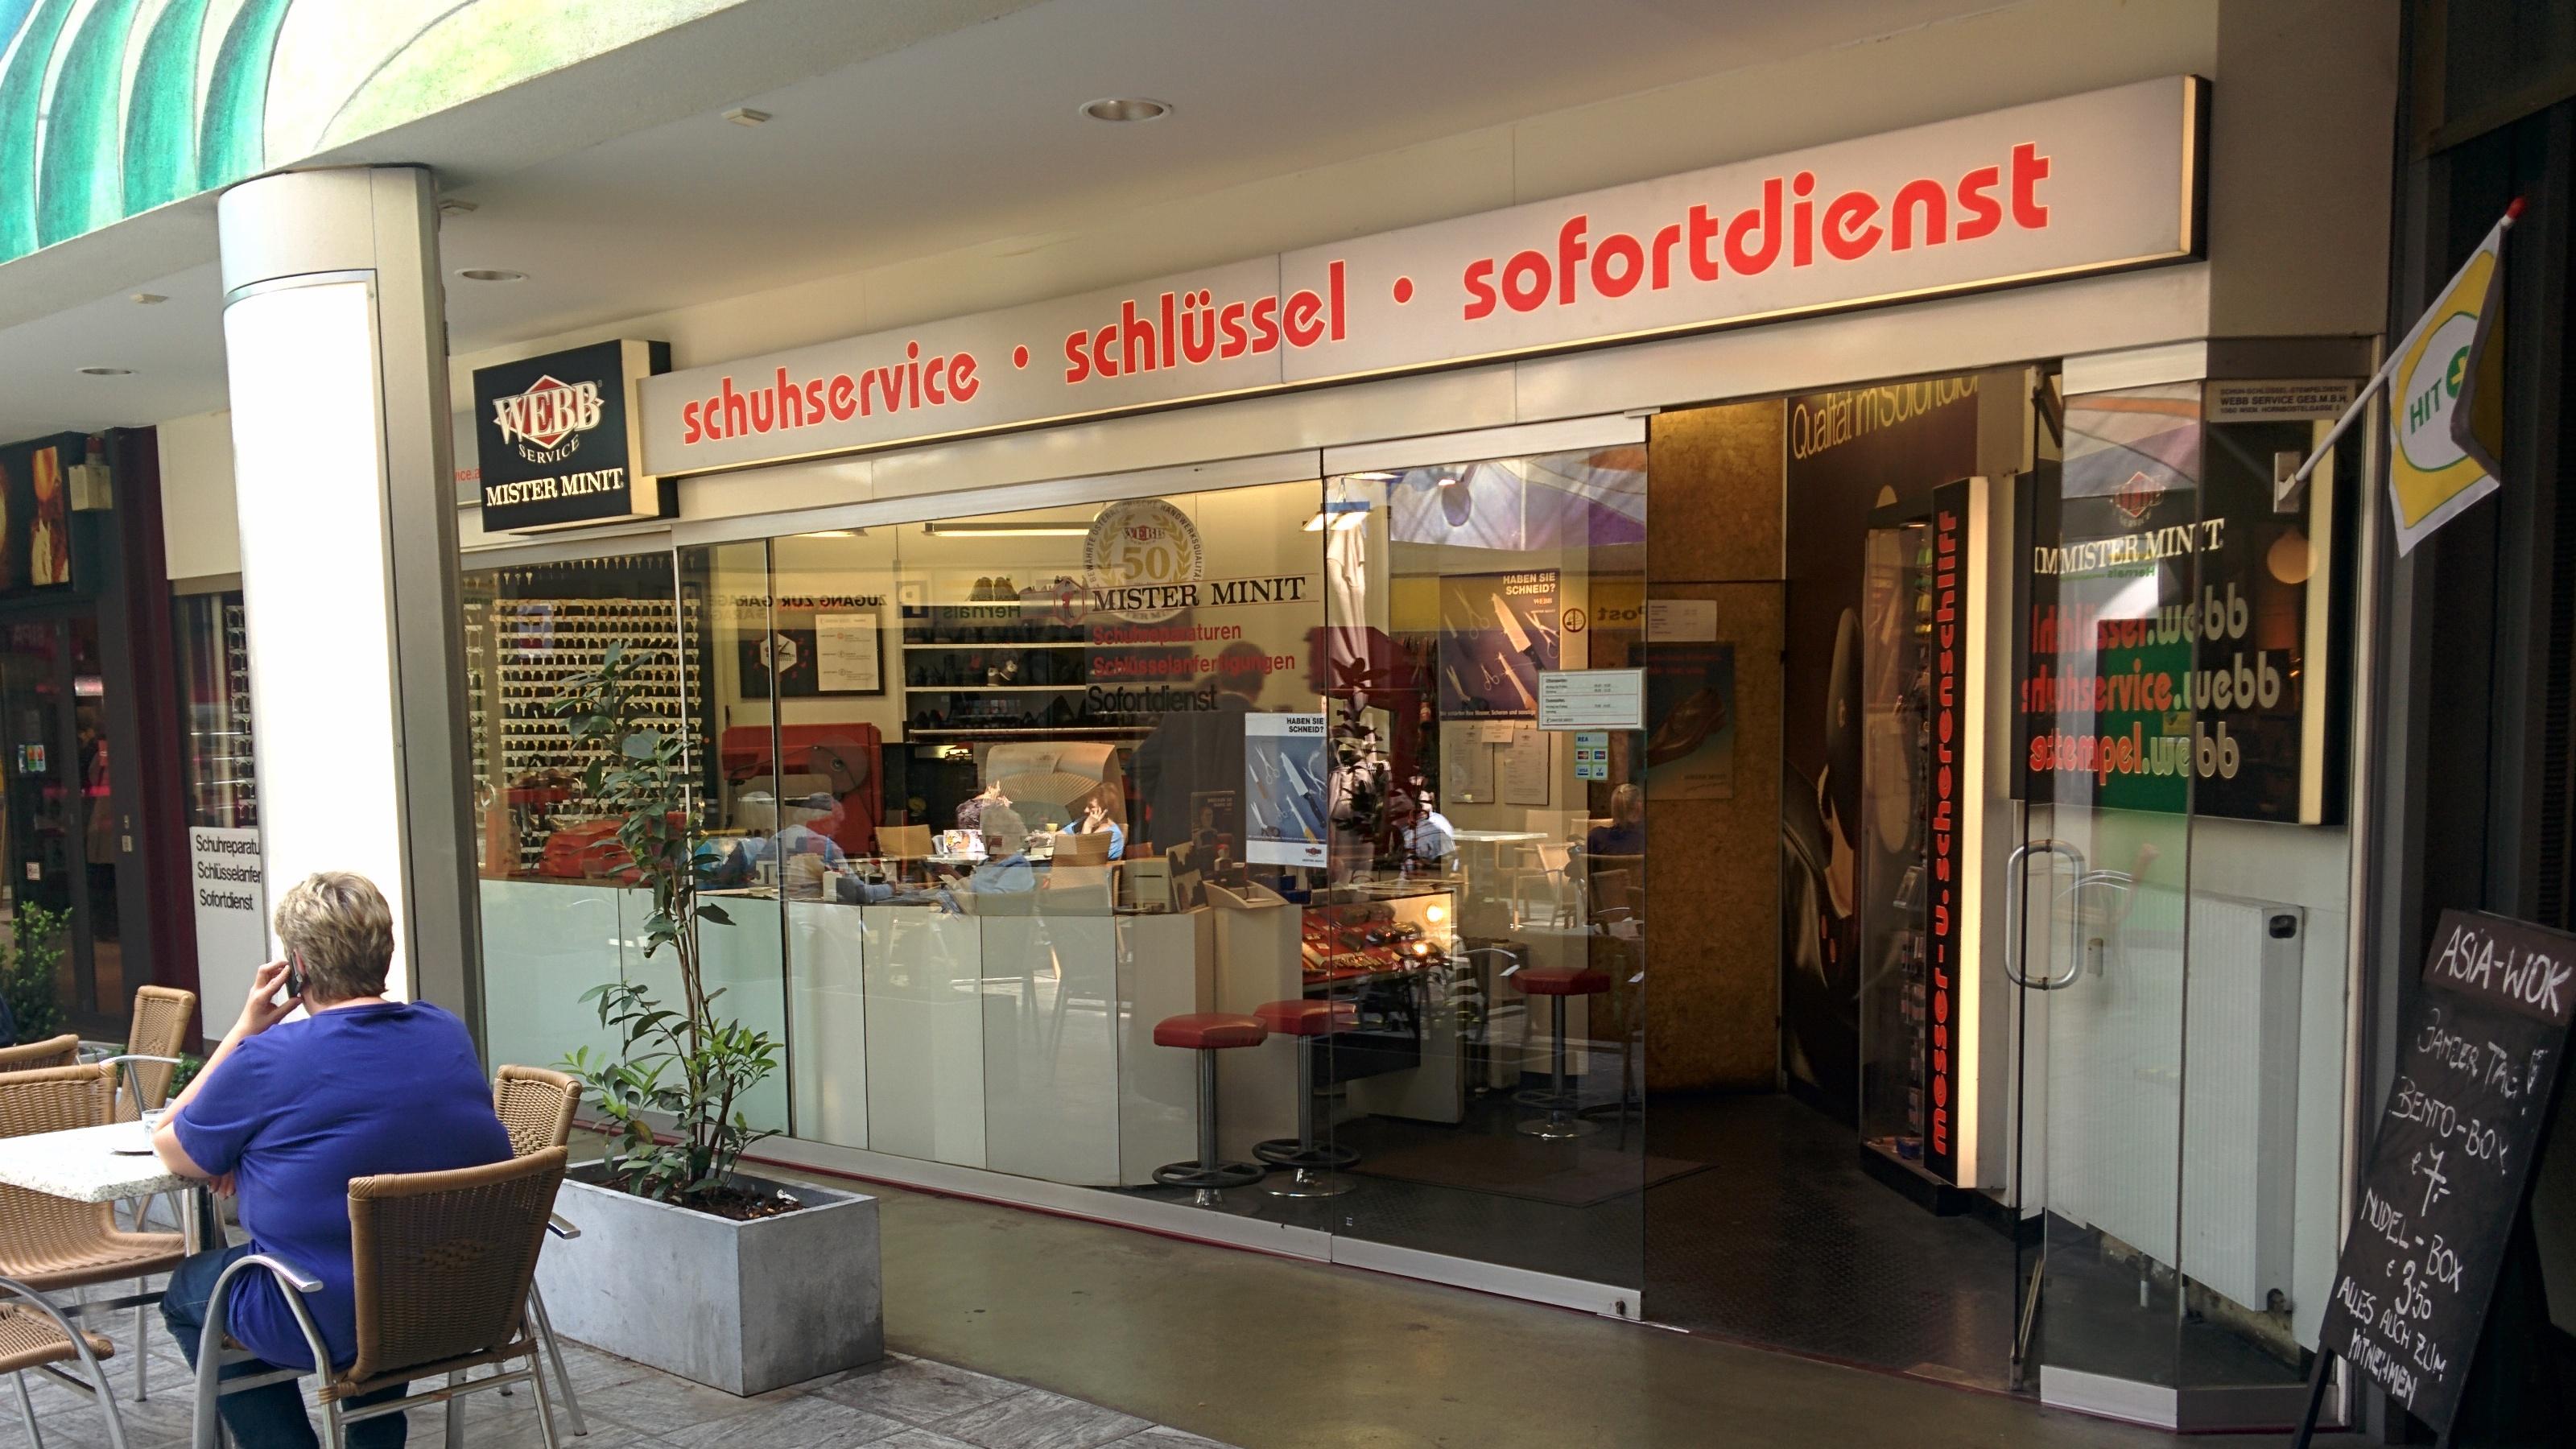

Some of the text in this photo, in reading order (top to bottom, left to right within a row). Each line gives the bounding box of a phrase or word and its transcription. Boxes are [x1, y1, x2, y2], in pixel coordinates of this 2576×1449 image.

[683, 141, 2051, 445] schuhservice schlüssel sofortdienst
[492, 381, 601, 444] WEBB
[2221, 396, 2248, 406] WEBB
[2252, 395, 2293, 405] SERVICE
[2409, 377, 2442, 435] HIT
[518, 434, 580, 464] SERVICE
[485, 467, 624, 507] MISTER MINIT
[2145, 518, 2225, 560] MINT
[1121, 546, 1170, 580] 50
[1503, 572, 1556, 584] HABEN SIE
[1092, 576, 1306, 612] MISTER MINIT
[1505, 583, 1556, 596] SCHNEID?
[1093, 623, 1241, 646] Schuhreparaturen
[1093, 652, 1295, 678] Schlüsselanfertigungen
[1088, 684, 1218, 712] Sofortdienst
[1289, 725, 1324, 733] SCHNEID?
[200, 888, 254, 911] Sofortdienst
[2380, 1308, 2412, 1349] AUCH
